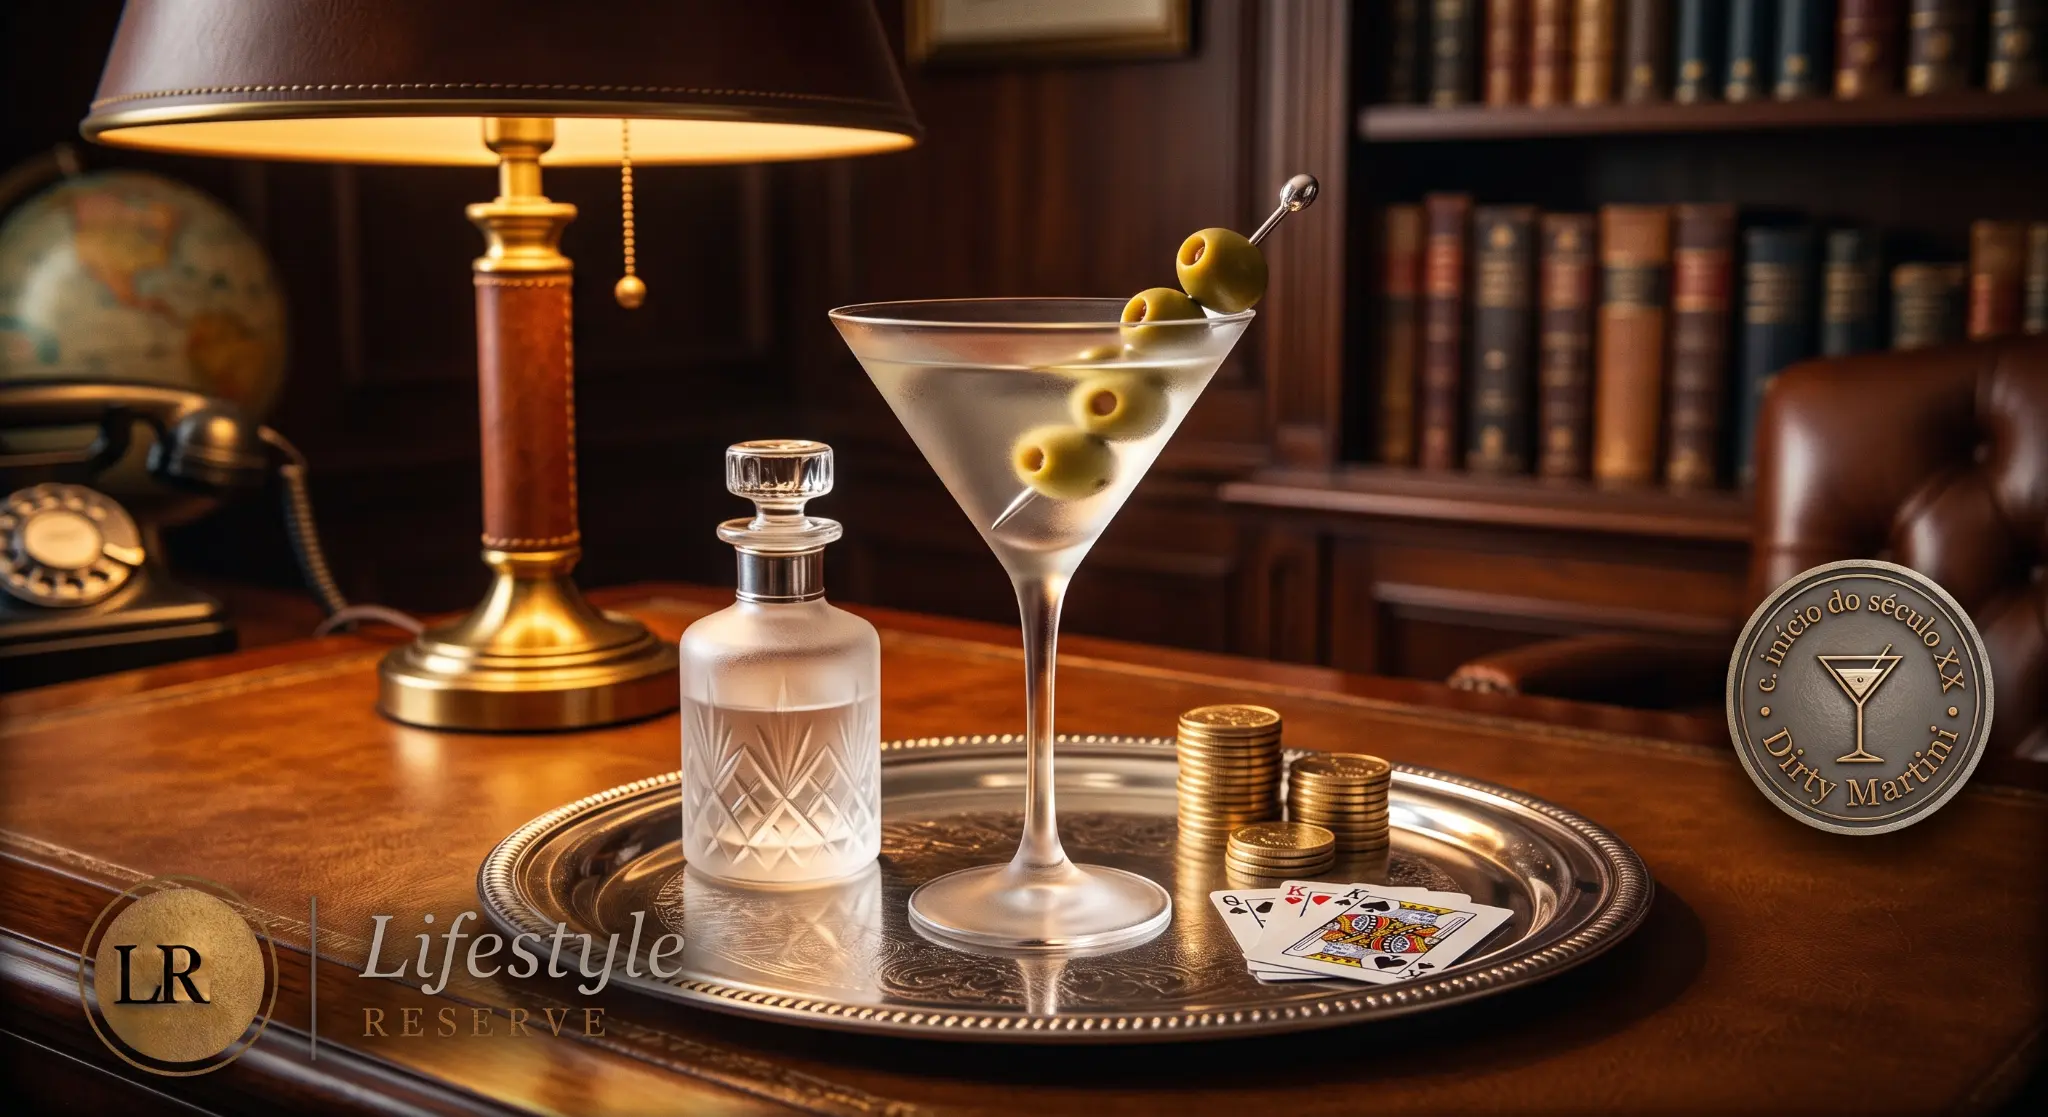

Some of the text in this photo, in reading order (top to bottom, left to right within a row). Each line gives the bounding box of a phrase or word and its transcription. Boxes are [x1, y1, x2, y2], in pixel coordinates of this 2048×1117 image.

[1288, 885, 1307, 896] K
[1343, 888, 1369, 901] K
[1222, 895, 1244, 907] Q
